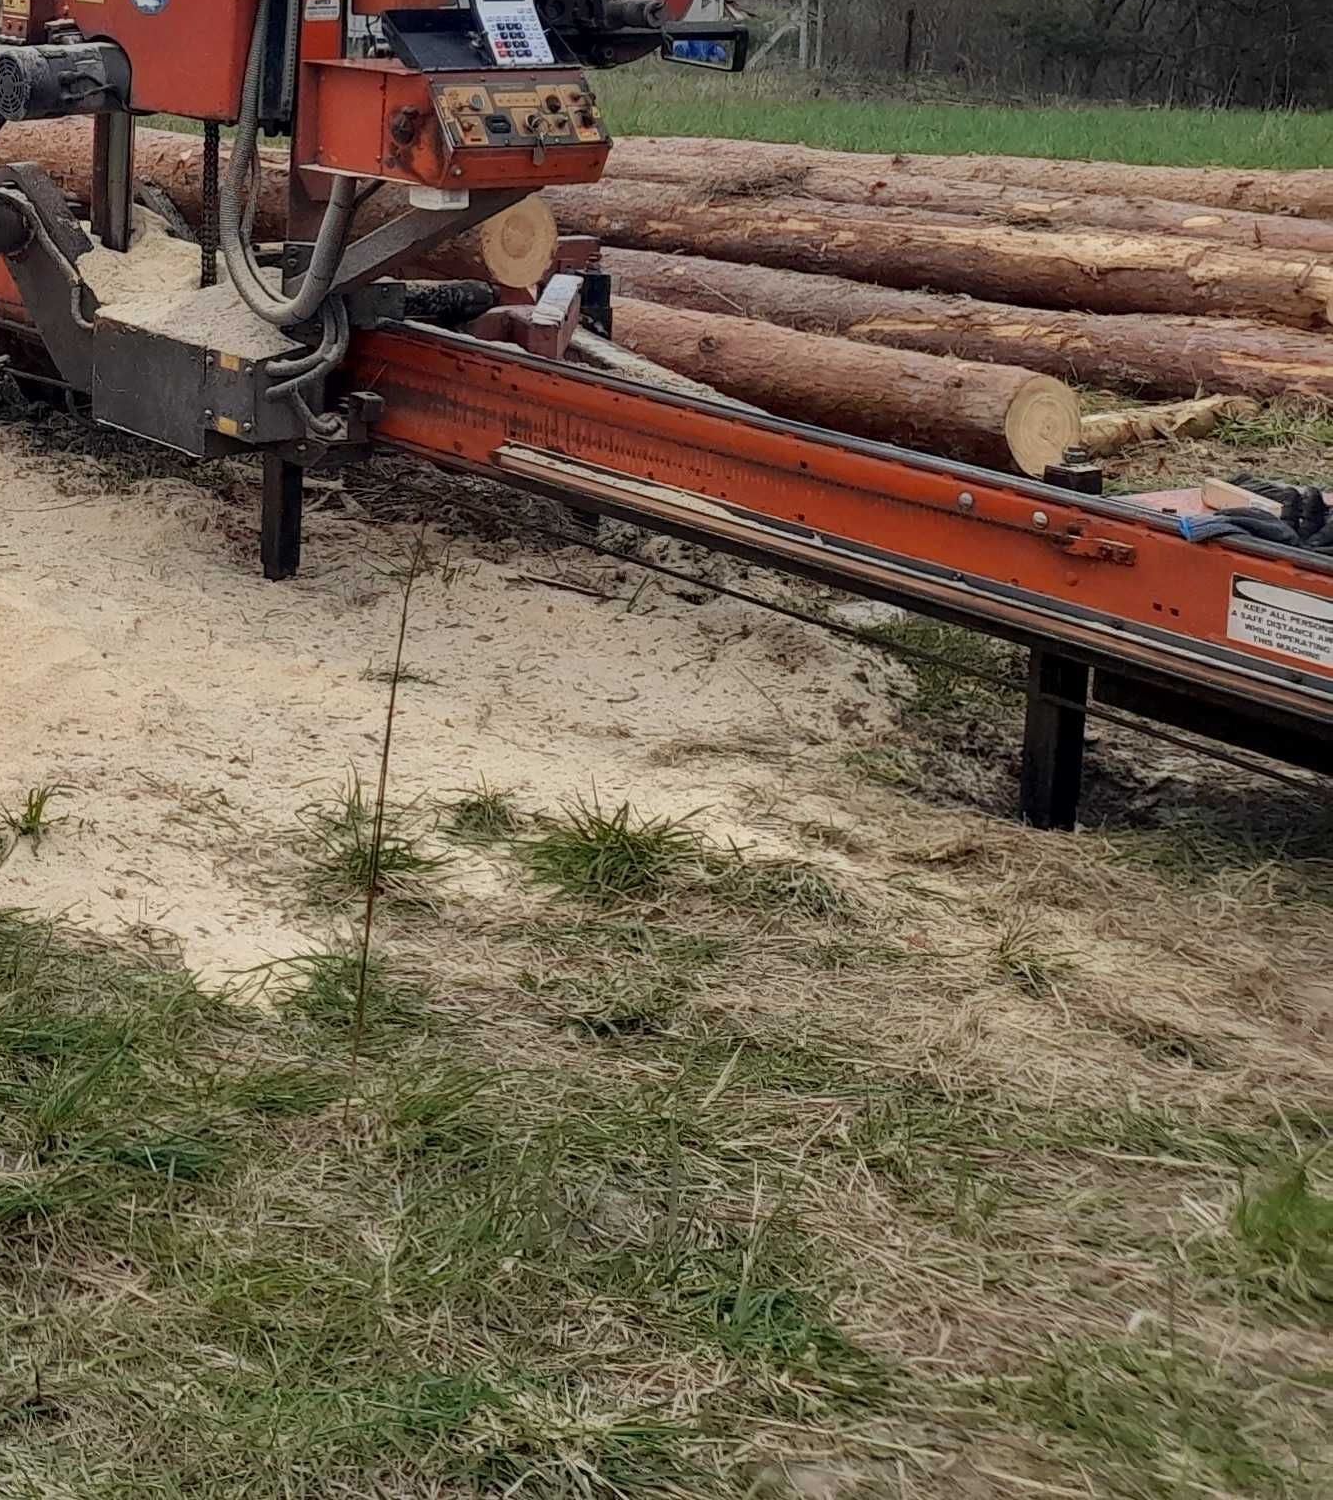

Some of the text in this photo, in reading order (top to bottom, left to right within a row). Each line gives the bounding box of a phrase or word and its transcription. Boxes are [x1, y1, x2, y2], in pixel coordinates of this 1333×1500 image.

[1243, 603, 1267, 613] KEEP
[1269, 611, 1286, 621] ALL
[1241, 612, 1263, 623] SAFE
[1266, 619, 1313, 638] DISTANCE
[1244, 623, 1330, 653] WHILE OPERATING
[1253, 635, 1320, 660] THIS MACHINE
